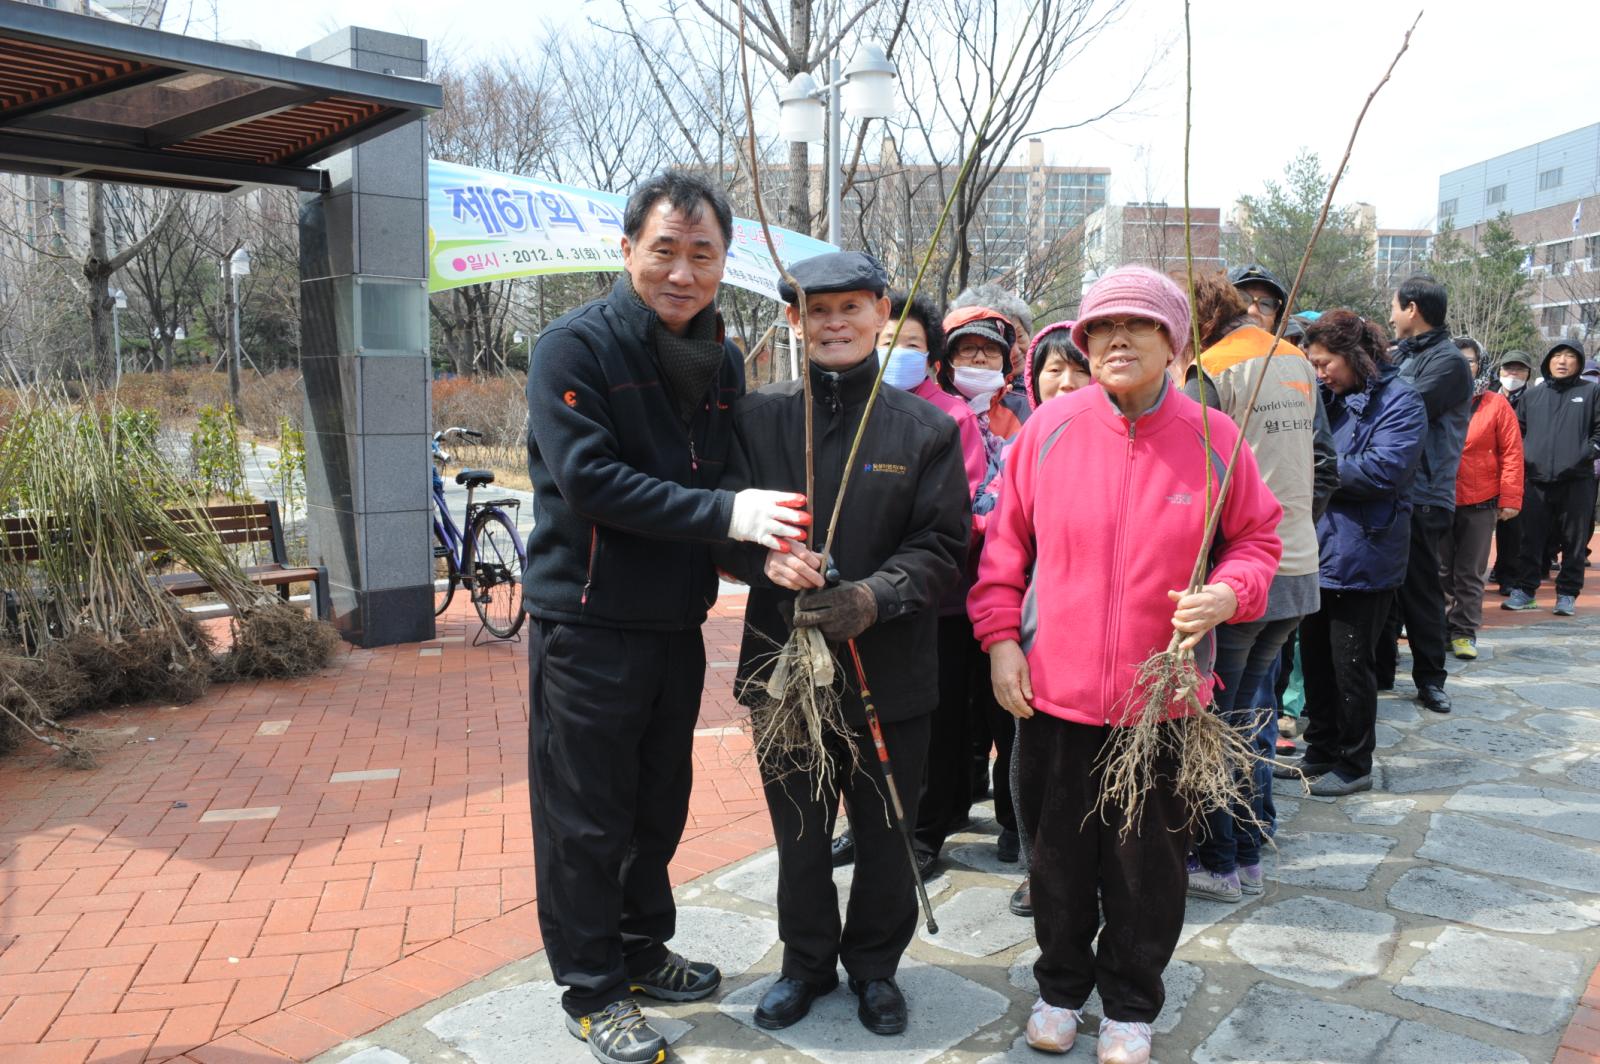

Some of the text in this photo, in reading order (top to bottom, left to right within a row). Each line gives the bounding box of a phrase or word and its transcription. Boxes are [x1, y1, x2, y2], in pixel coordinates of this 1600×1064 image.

[443, 185, 625, 236] 제67회 식
[466, 252, 500, 271] 일시
[512, 248, 553, 264] 2012.
[572, 247, 601, 261] 3(화)
[604, 248, 624, 260] 14:
[1282, 399, 1306, 409] Vision
